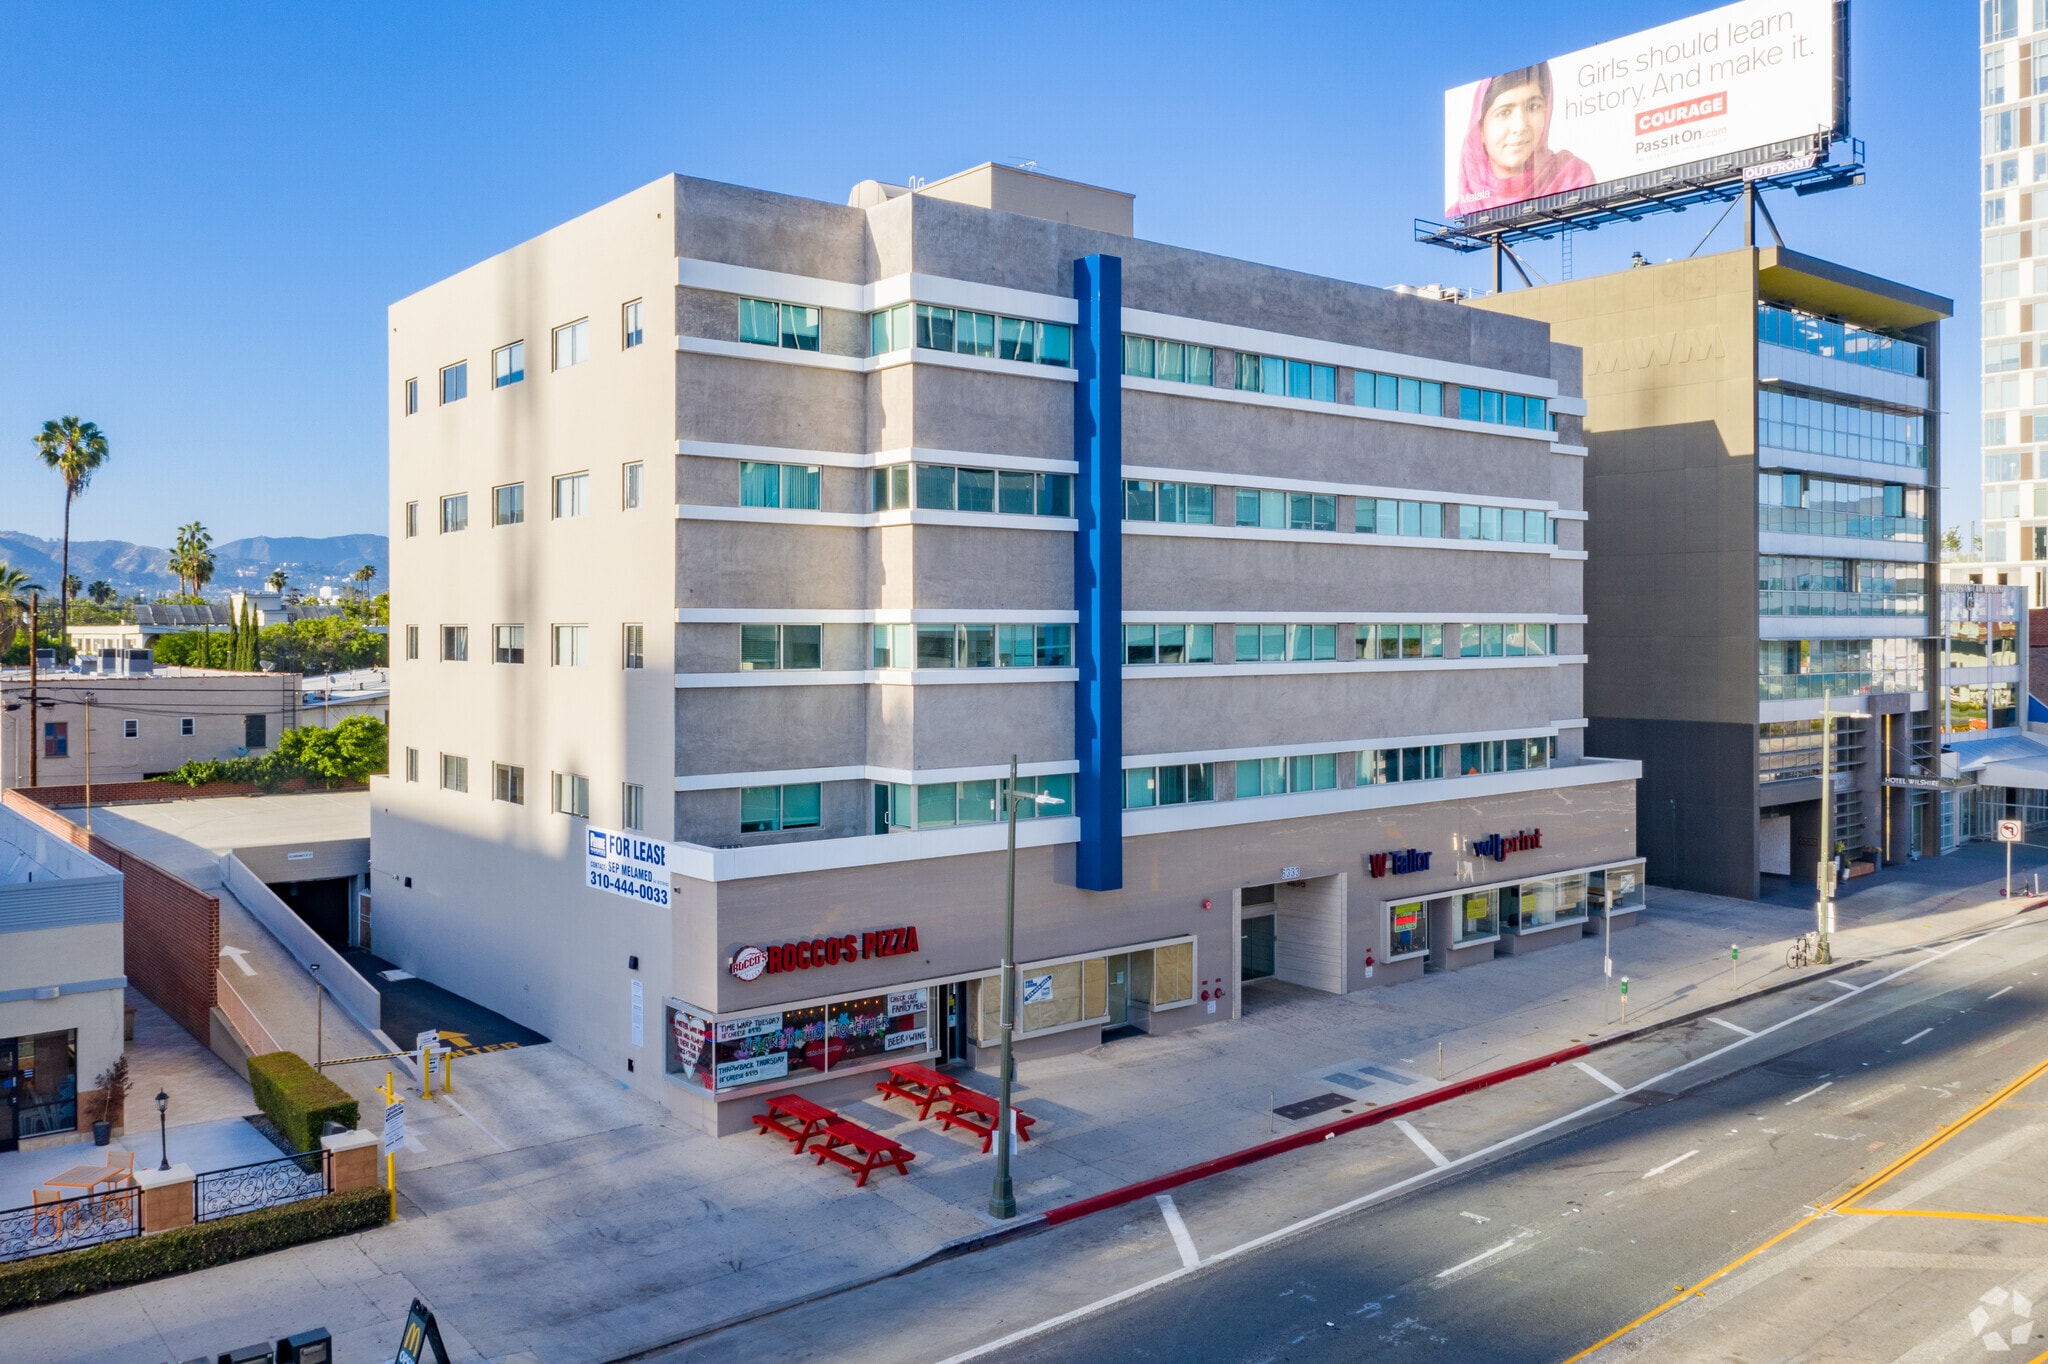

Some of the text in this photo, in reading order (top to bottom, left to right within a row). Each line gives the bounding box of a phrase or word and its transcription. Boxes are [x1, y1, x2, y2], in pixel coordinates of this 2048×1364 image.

[1578, 11, 1793, 88] Girls should learn
[1565, 34, 1815, 120] history. And make it.
[1638, 97, 1724, 130] COURAGE
[1460, 189, 1491, 204] Malala
[1885, 777, 1940, 787] HOTEL WILSHIRE
[609, 835, 666, 866] FOR LEASE
[608, 861, 620, 874] SEP
[621, 864, 653, 882] MELAMED
[1370, 848, 1432, 878] W Tailor
[590, 871, 668, 905] 310-444-0033
[767, 926, 919, 974] ROCCO'S PIZZA
[732, 952, 768, 973] ROCCO'S
[908, 992, 918, 1000] OUT
[892, 1004, 912, 1014] FAMILY
[720, 1016, 780, 1033] TIME WARP TUESDAY
[740, 1040, 757, 1052] WE
[764, 1035, 783, 1049] ARE
[785, 1033, 797, 1045] IN
[833, 1015, 890, 1034] TOGETHER
[888, 1034, 905, 1048] BEER
[909, 1030, 927, 1042] WINE
[718, 1056, 785, 1075] THROWBACK THURSDAY
